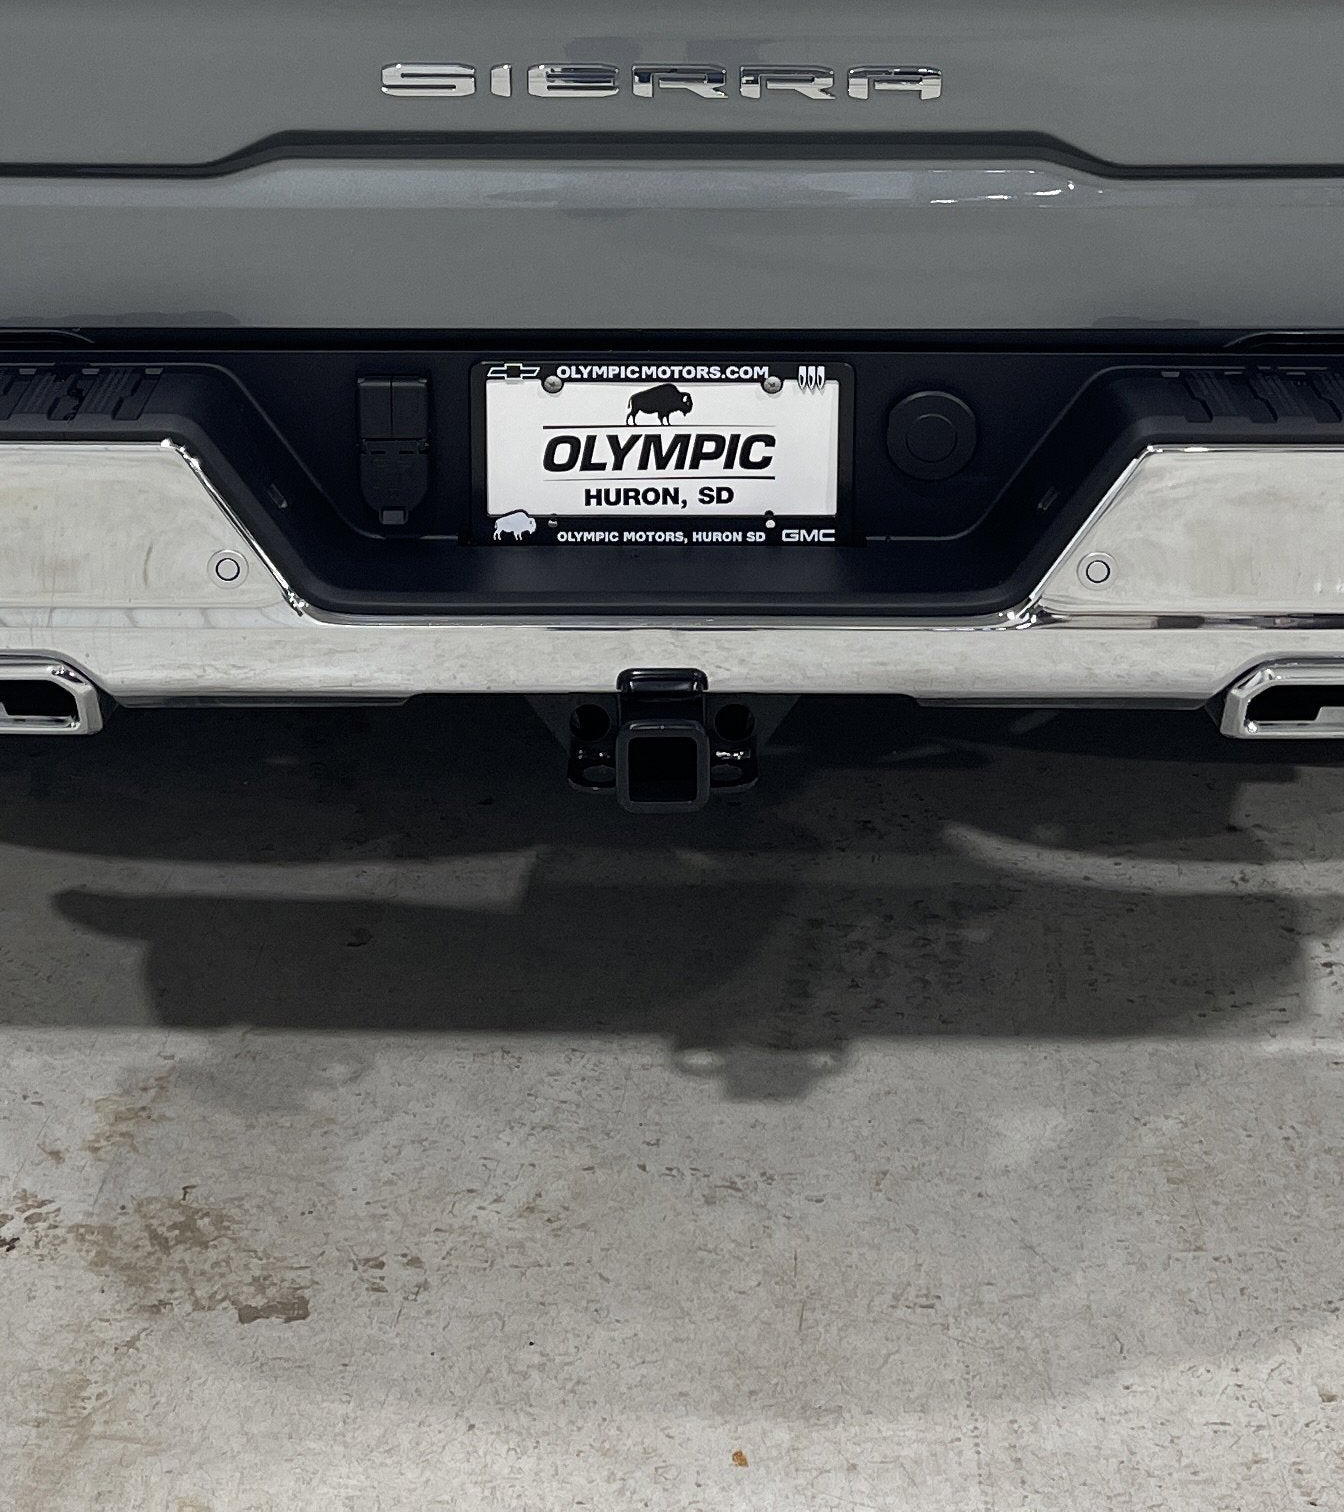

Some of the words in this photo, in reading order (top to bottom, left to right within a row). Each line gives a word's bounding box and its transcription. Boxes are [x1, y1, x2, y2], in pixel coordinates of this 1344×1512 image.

[379, 61, 943, 102] SIERRA
[556, 365, 769, 380] OLYMPICMOTORS.COM
[542, 433, 776, 473] OLYMPIC
[584, 487, 688, 509] HURON,
[697, 486, 734, 505] SD
[557, 531, 620, 543] OLYMPIC
[623, 531, 689, 544] MOTORS,
[692, 531, 743, 543] HURON
[746, 531, 766, 543] SD
[781, 529, 836, 542] GMC
